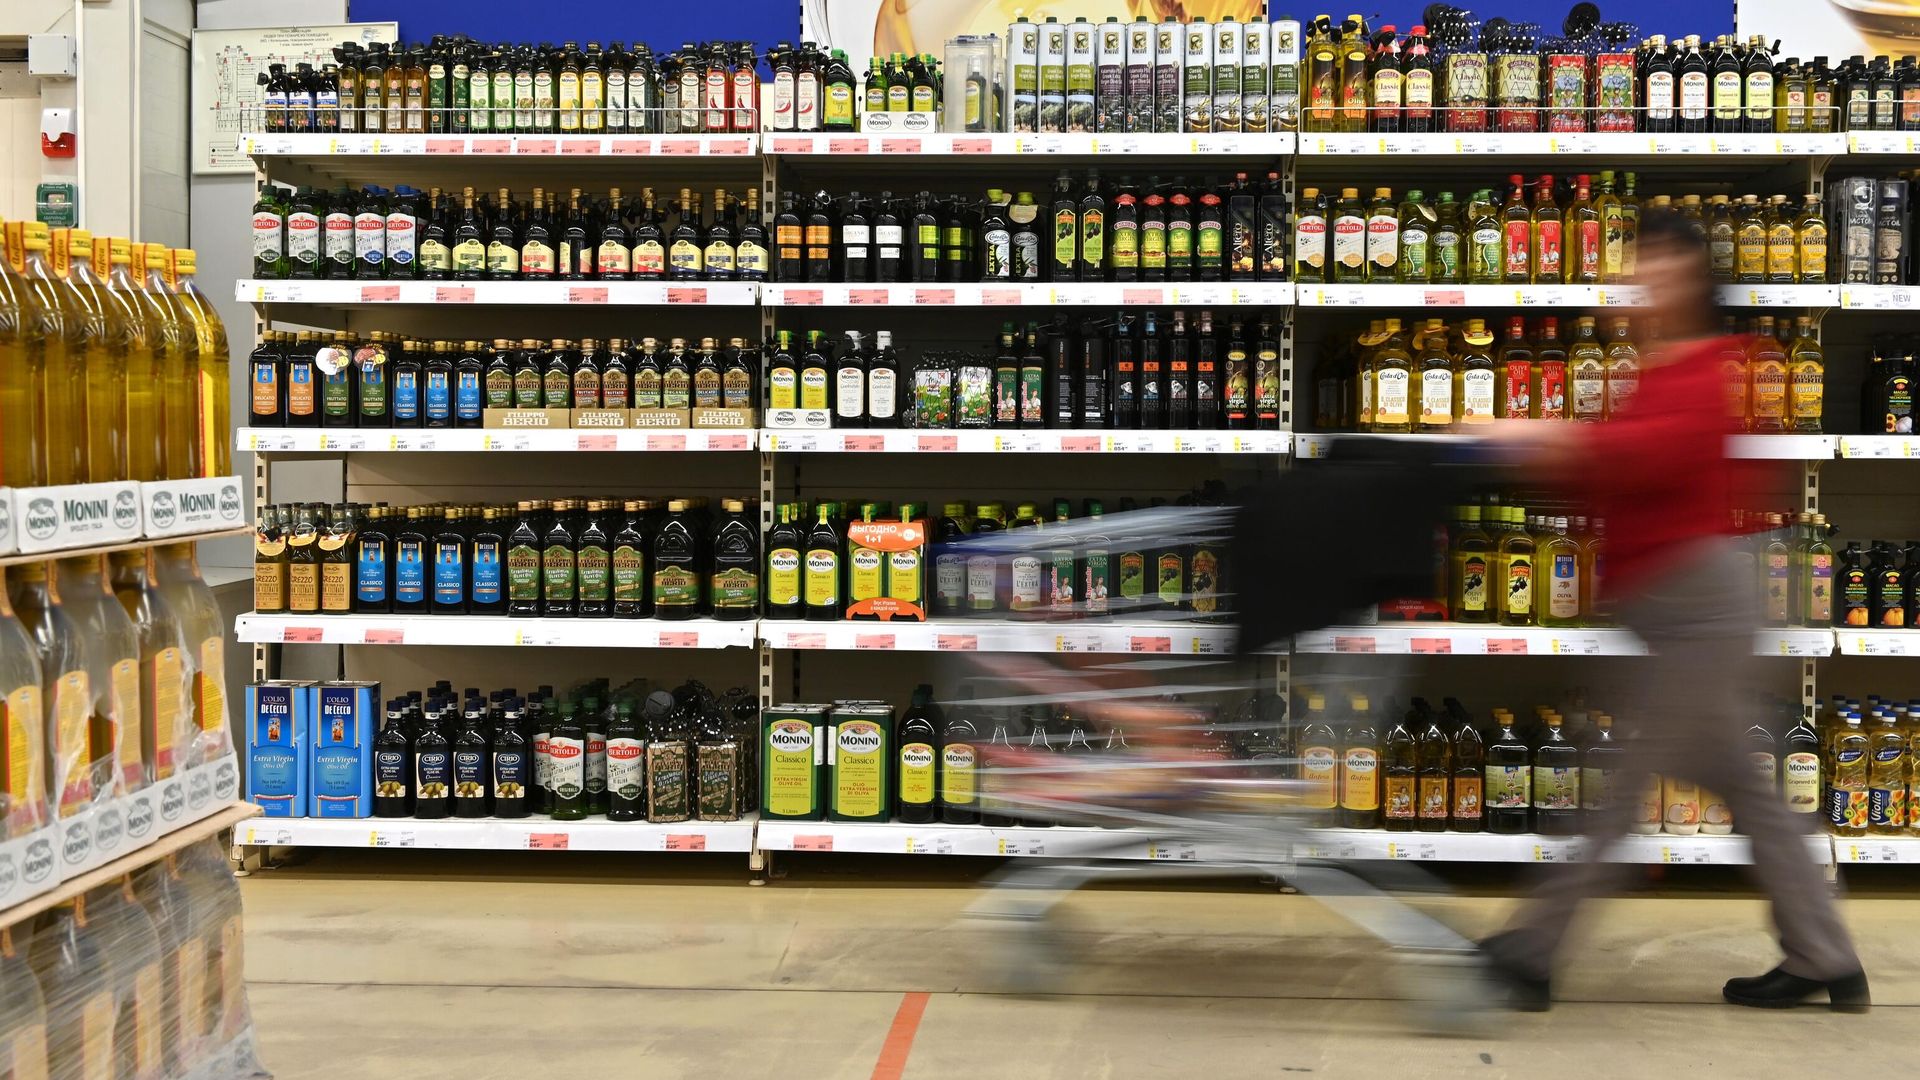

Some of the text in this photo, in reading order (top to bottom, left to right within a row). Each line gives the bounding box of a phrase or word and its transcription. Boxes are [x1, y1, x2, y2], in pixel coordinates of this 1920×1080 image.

[1265, 223, 1273, 254] Altero
[1892, 294, 1910, 302] NEW
[1425, 373, 1438, 381] Costa
[1466, 373, 1480, 381] Costa
[502, 417, 549, 426] BERIO
[578, 418, 624, 426] BERIO
[698, 417, 744, 425] BERIO
[180, 493, 215, 512] MONINI
[221, 501, 238, 510] MONINI
[64, 499, 108, 522] MONINI
[153, 507, 174, 518] MONINI
[29, 517, 56, 529] MONINI
[851, 525, 897, 534] ВЫГОДНО
[865, 536, 882, 544] 1+1
[855, 558, 878, 566] MONINI
[893, 558, 916, 567] MONINI
[261, 704, 287, 714] DE CECCO
[324, 705, 350, 715] DE CECCO
[772, 735, 810, 746] MONINI
[840, 736, 878, 747] MONINI
[273, 755, 294, 763] Virgin
[336, 756, 358, 764] Virgin
[776, 755, 806, 764] Classico
[904, 754, 931, 763] MONINI
[946, 754, 973, 764] MONINI
[1838, 752, 1845, 761] 4
[1877, 751, 1884, 760] 4
[844, 757, 874, 765] Classico
[1347, 759, 1375, 769] MONINI
[1788, 765, 1817, 773] MONINI
[1832, 792, 1841, 821] Violio
[1871, 792, 1881, 821] Violio
